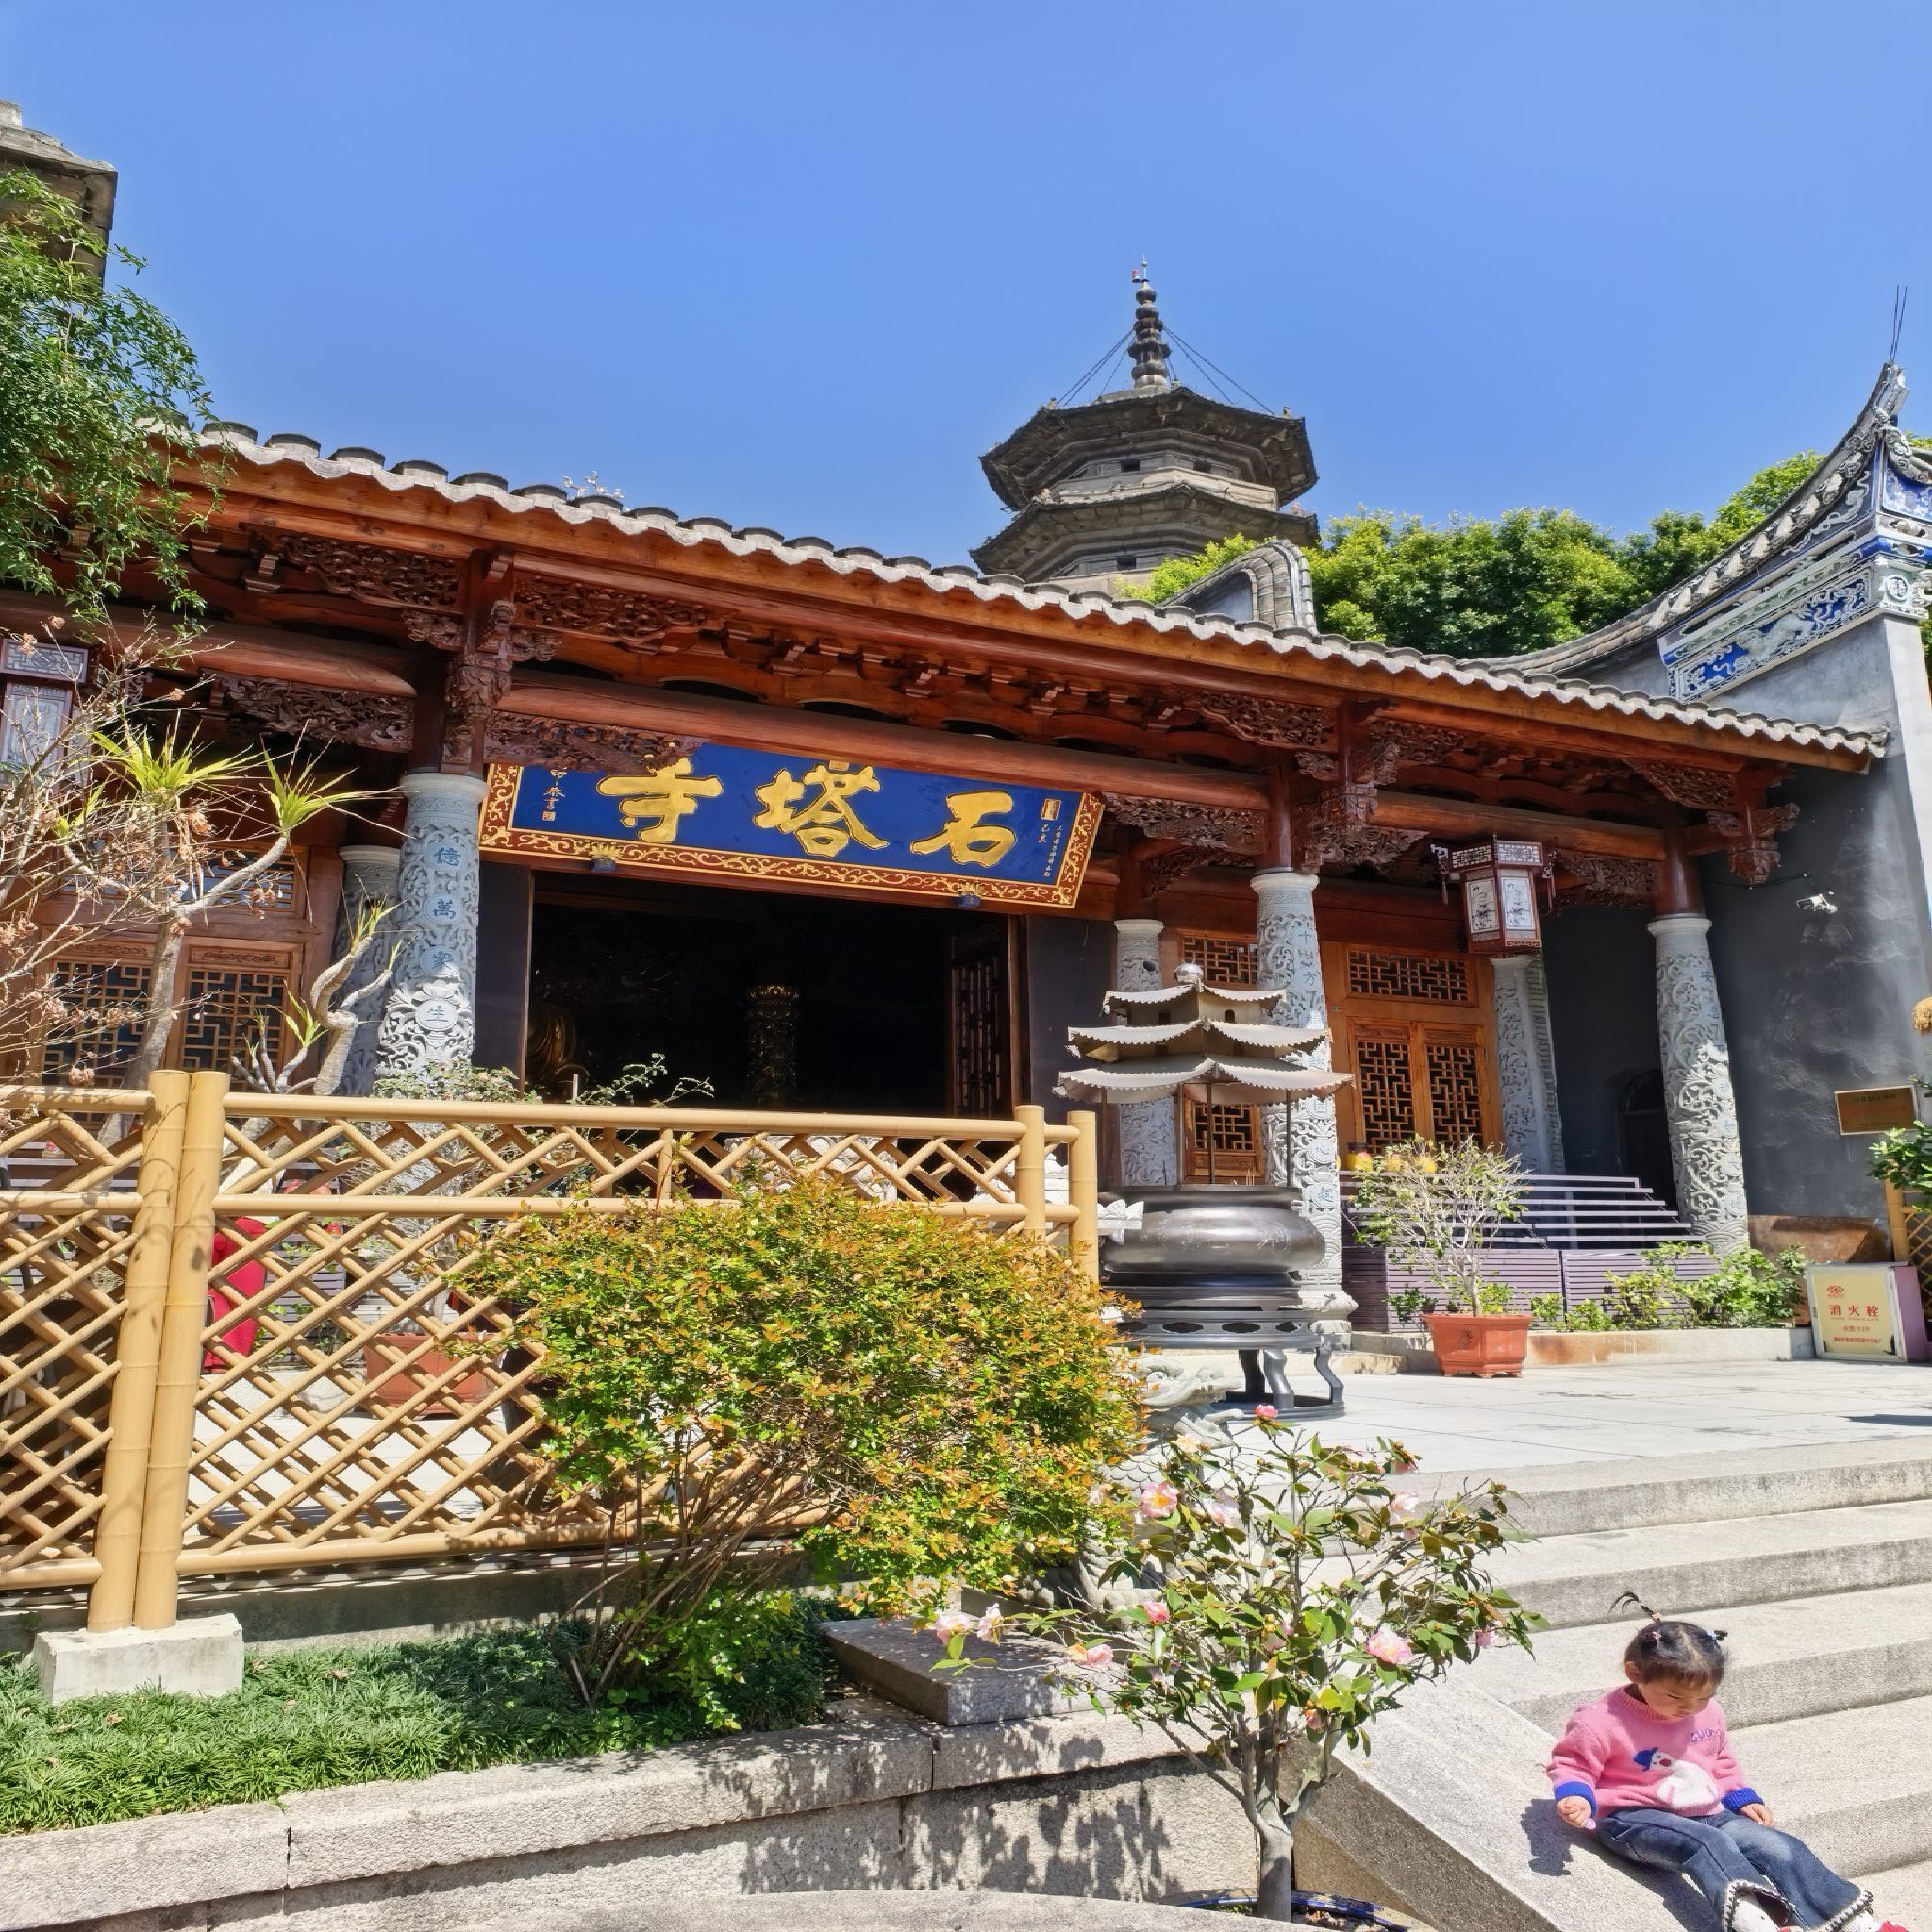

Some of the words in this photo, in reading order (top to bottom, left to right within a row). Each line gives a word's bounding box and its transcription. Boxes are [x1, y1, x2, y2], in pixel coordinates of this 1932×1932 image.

[596, 757, 1018, 868] 石塔寺
[1829, 1305, 1879, 1317] 消火栓
